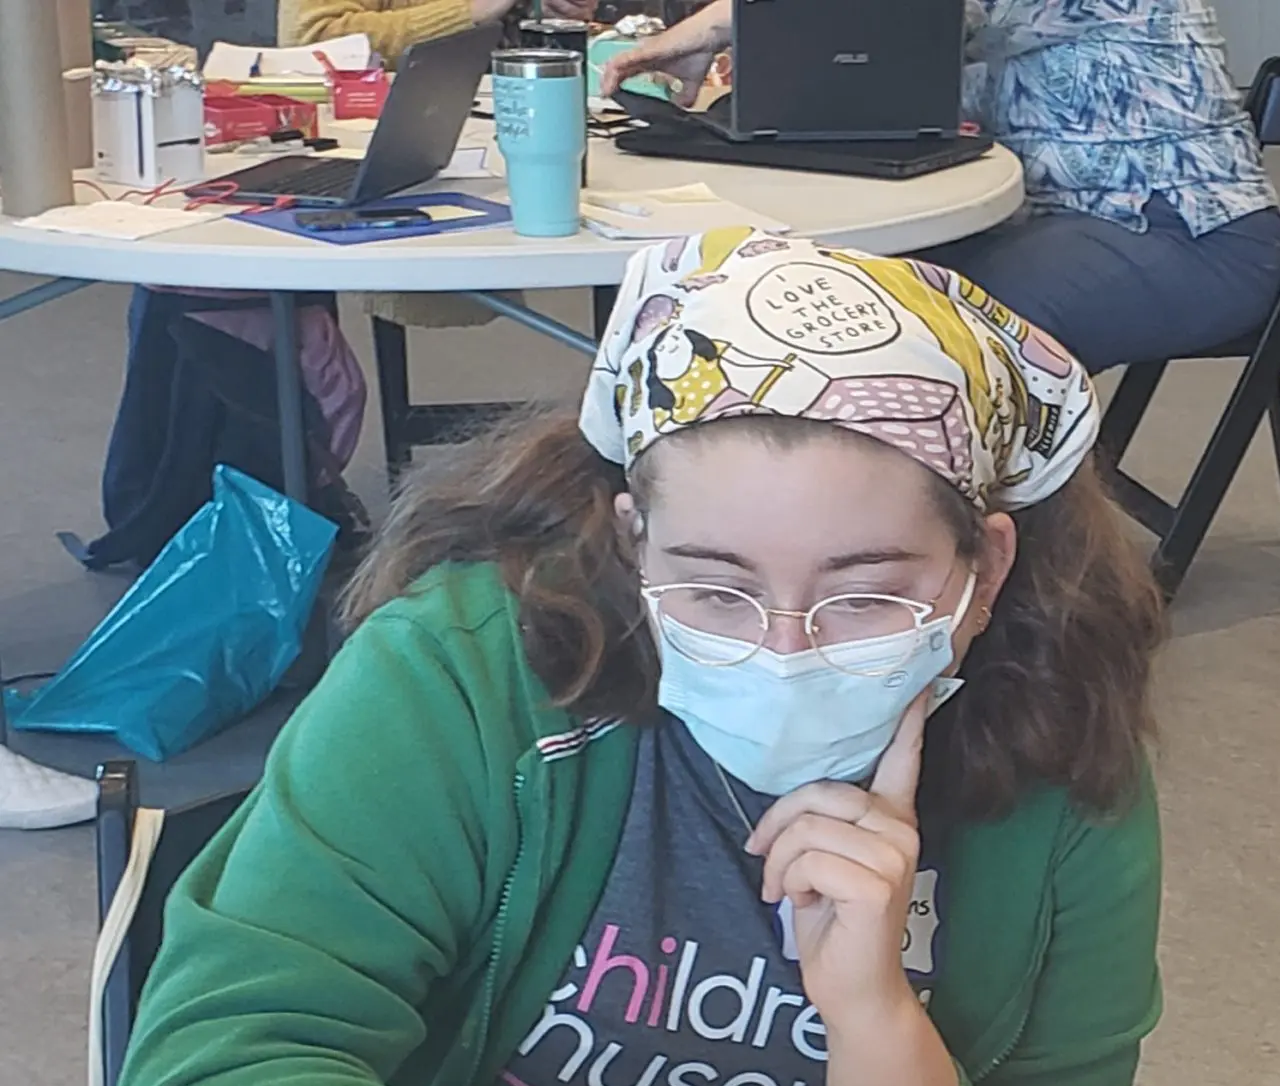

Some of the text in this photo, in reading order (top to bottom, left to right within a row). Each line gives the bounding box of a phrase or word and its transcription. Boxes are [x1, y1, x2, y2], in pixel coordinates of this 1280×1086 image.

[833, 53, 869, 64] ASUS
[776, 274, 787, 283] I
[765, 277, 833, 311] LOVE
[793, 295, 844, 318] THE
[786, 301, 880, 340] GROCERY
[820, 320, 887, 349] STORE
